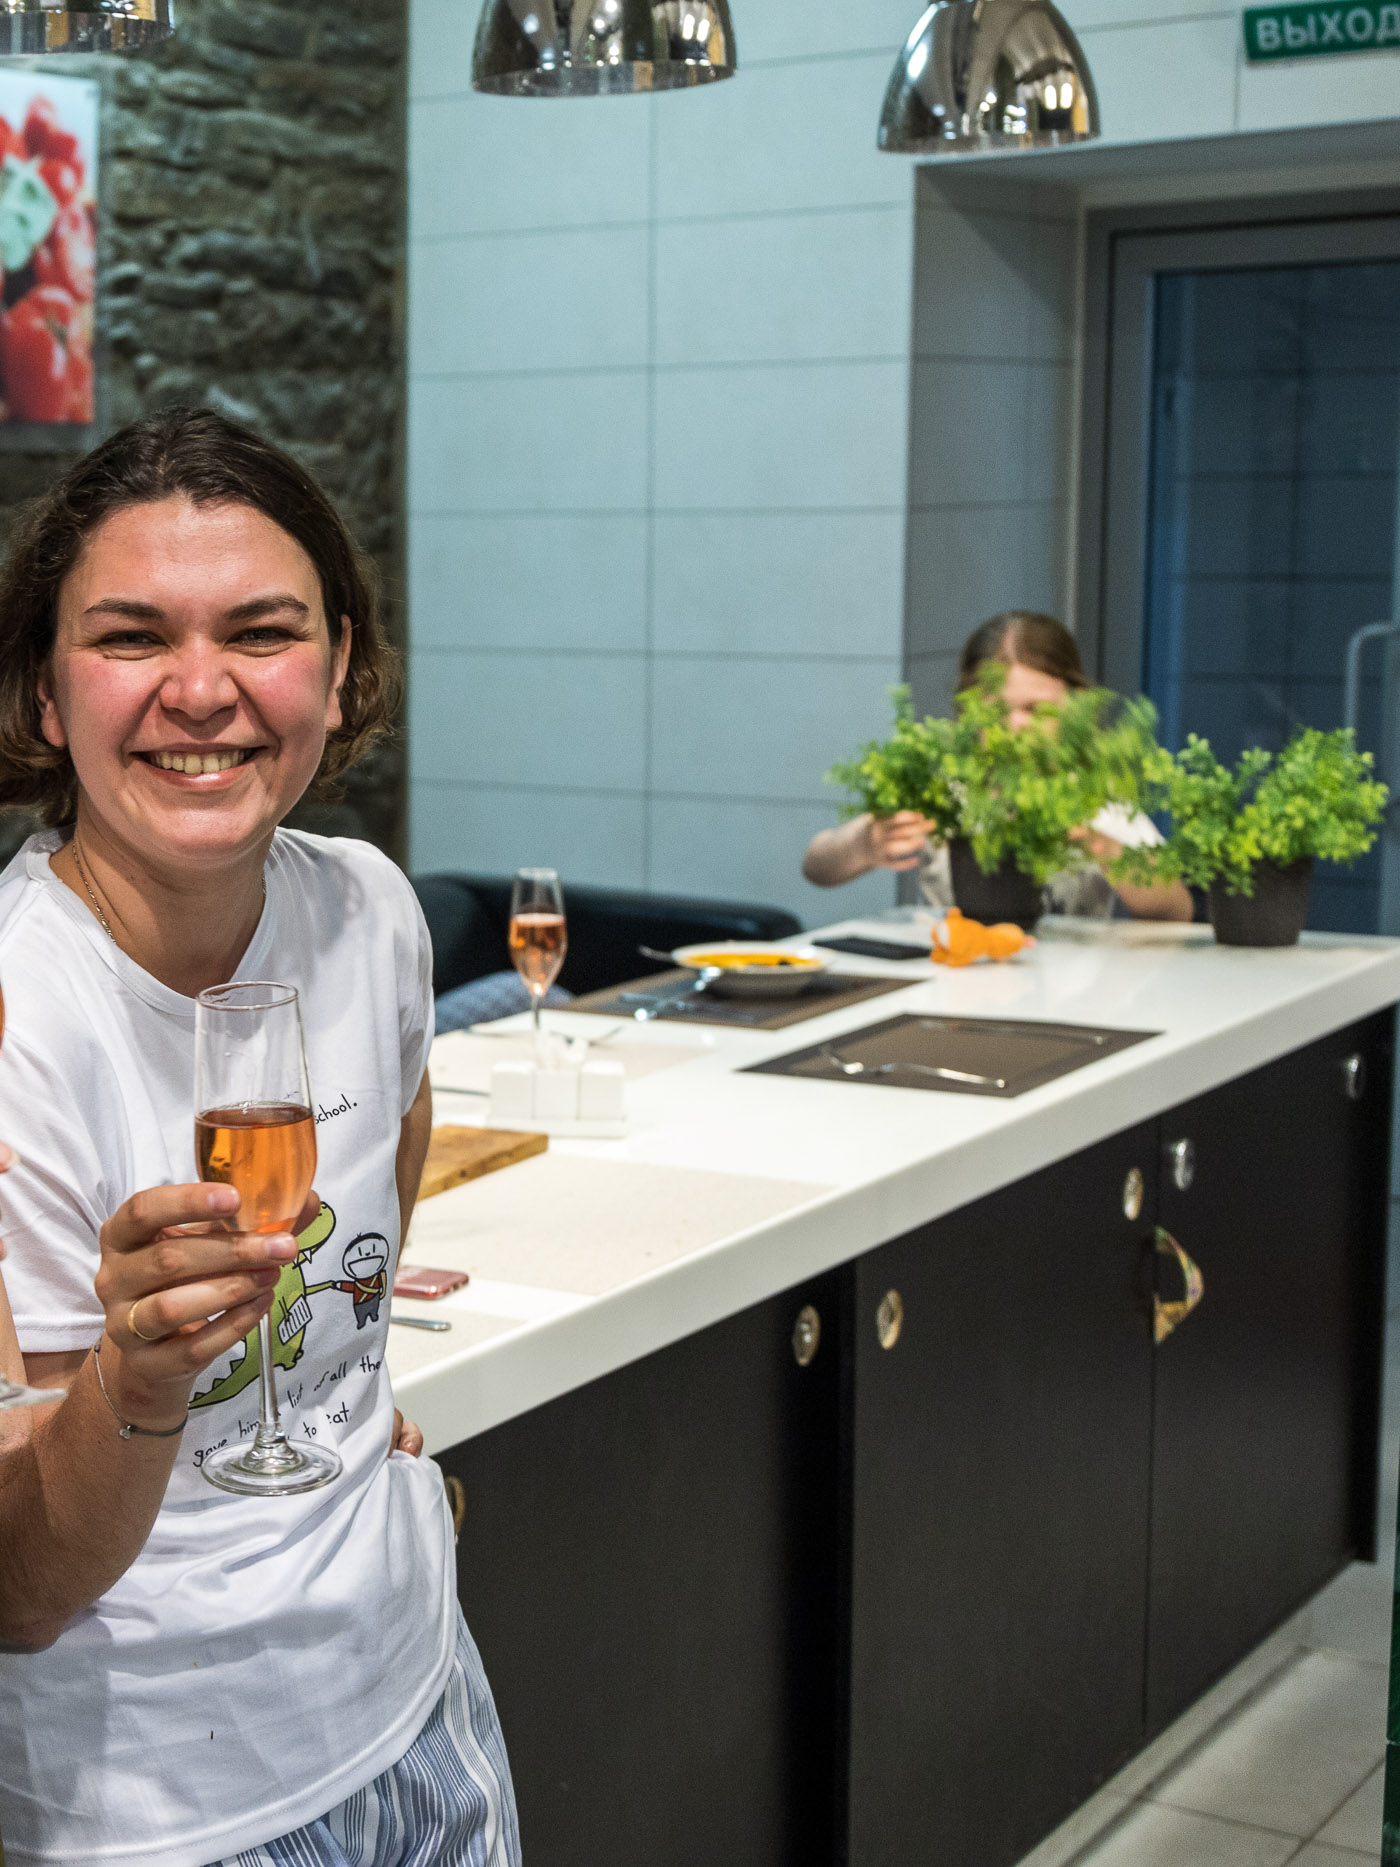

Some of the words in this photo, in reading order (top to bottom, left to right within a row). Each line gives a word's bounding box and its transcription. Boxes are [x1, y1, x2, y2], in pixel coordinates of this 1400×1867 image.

[1255, 4, 1400, 51] ВЫХОД
[287, 1382, 304, 1409] list
[330, 1360, 348, 1382] all
[359, 1355, 382, 1374] the
[302, 1421, 317, 1439] to
